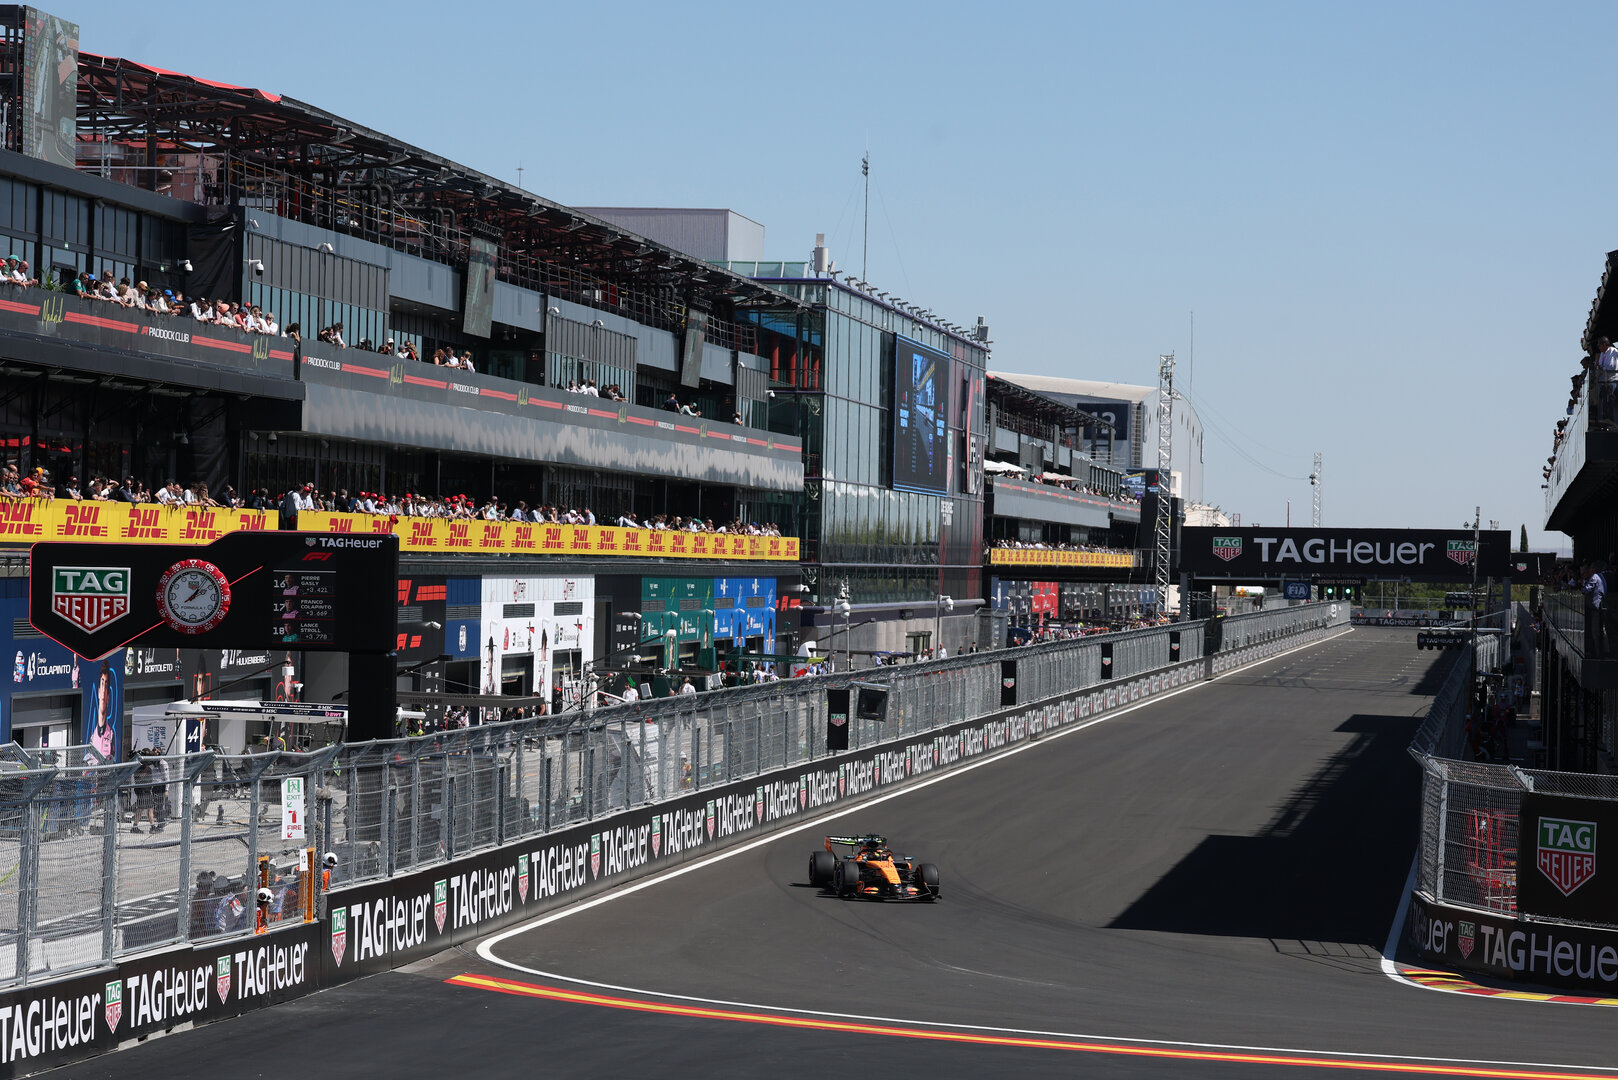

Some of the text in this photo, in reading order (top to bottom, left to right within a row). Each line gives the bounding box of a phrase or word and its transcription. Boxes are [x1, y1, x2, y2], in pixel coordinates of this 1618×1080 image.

[149, 327, 175, 341] PADDOCK
[175, 331, 189, 343] CLUB
[308, 356, 329, 368] PADDOCK
[329, 360, 340, 370] CLUB
[470, 386, 479, 394] CLUB
[0, 502, 34, 534] DHL
[64, 505, 101, 536] DHL
[128, 509, 161, 538] DHL
[186, 512, 216, 539] DHL
[320, 538, 382, 548] TAGHeuer
[412, 522, 433, 546] DHL
[449, 524, 468, 546] DHL
[483, 525, 502, 548] DHL
[515, 527, 533, 548] DHL
[545, 528, 562, 548] DHL
[574, 529, 588, 549] DHL
[1450, 542, 1474, 550] TAG
[1215, 548, 1240, 560] HEUER
[1254, 538, 1435, 564] TAGHeuer
[60, 572, 122, 592] TAG
[274, 580, 286, 588] 16
[1288, 586, 1307, 595] FIA
[57, 597, 125, 628] HEUER
[27, 652, 36, 682] 43
[37, 664, 70, 676] COLAPINTO
[137, 650, 142, 674] 5
[145, 663, 173, 673] BORTOLETO
[236, 655, 266, 666] HULKENBERG
[807, 769, 838, 808] TAGHeuer
[846, 760, 874, 796] TAGHeuer
[765, 781, 799, 822] TAGHeuer
[717, 793, 755, 838] TAGHeuer
[662, 808, 705, 854] TAGHeuer
[1543, 823, 1591, 850] TAG
[602, 824, 649, 876] TAGHeuer
[532, 843, 588, 900] TAGHeuer
[1540, 853, 1592, 895] HEUER
[435, 881, 446, 902] TAG
[451, 866, 515, 929] TAGHeuer
[333, 910, 345, 931] TAG
[351, 892, 431, 960] TAGHeuer
[1460, 923, 1474, 936] TAG
[1481, 925, 1618, 982] TAGHeue
[218, 957, 230, 975] TAG
[235, 941, 308, 1000] TAGHeuer
[106, 982, 121, 1001] TAG
[127, 964, 213, 1028] TAGHeuer
[0, 991, 100, 1064] TAGHeuer
